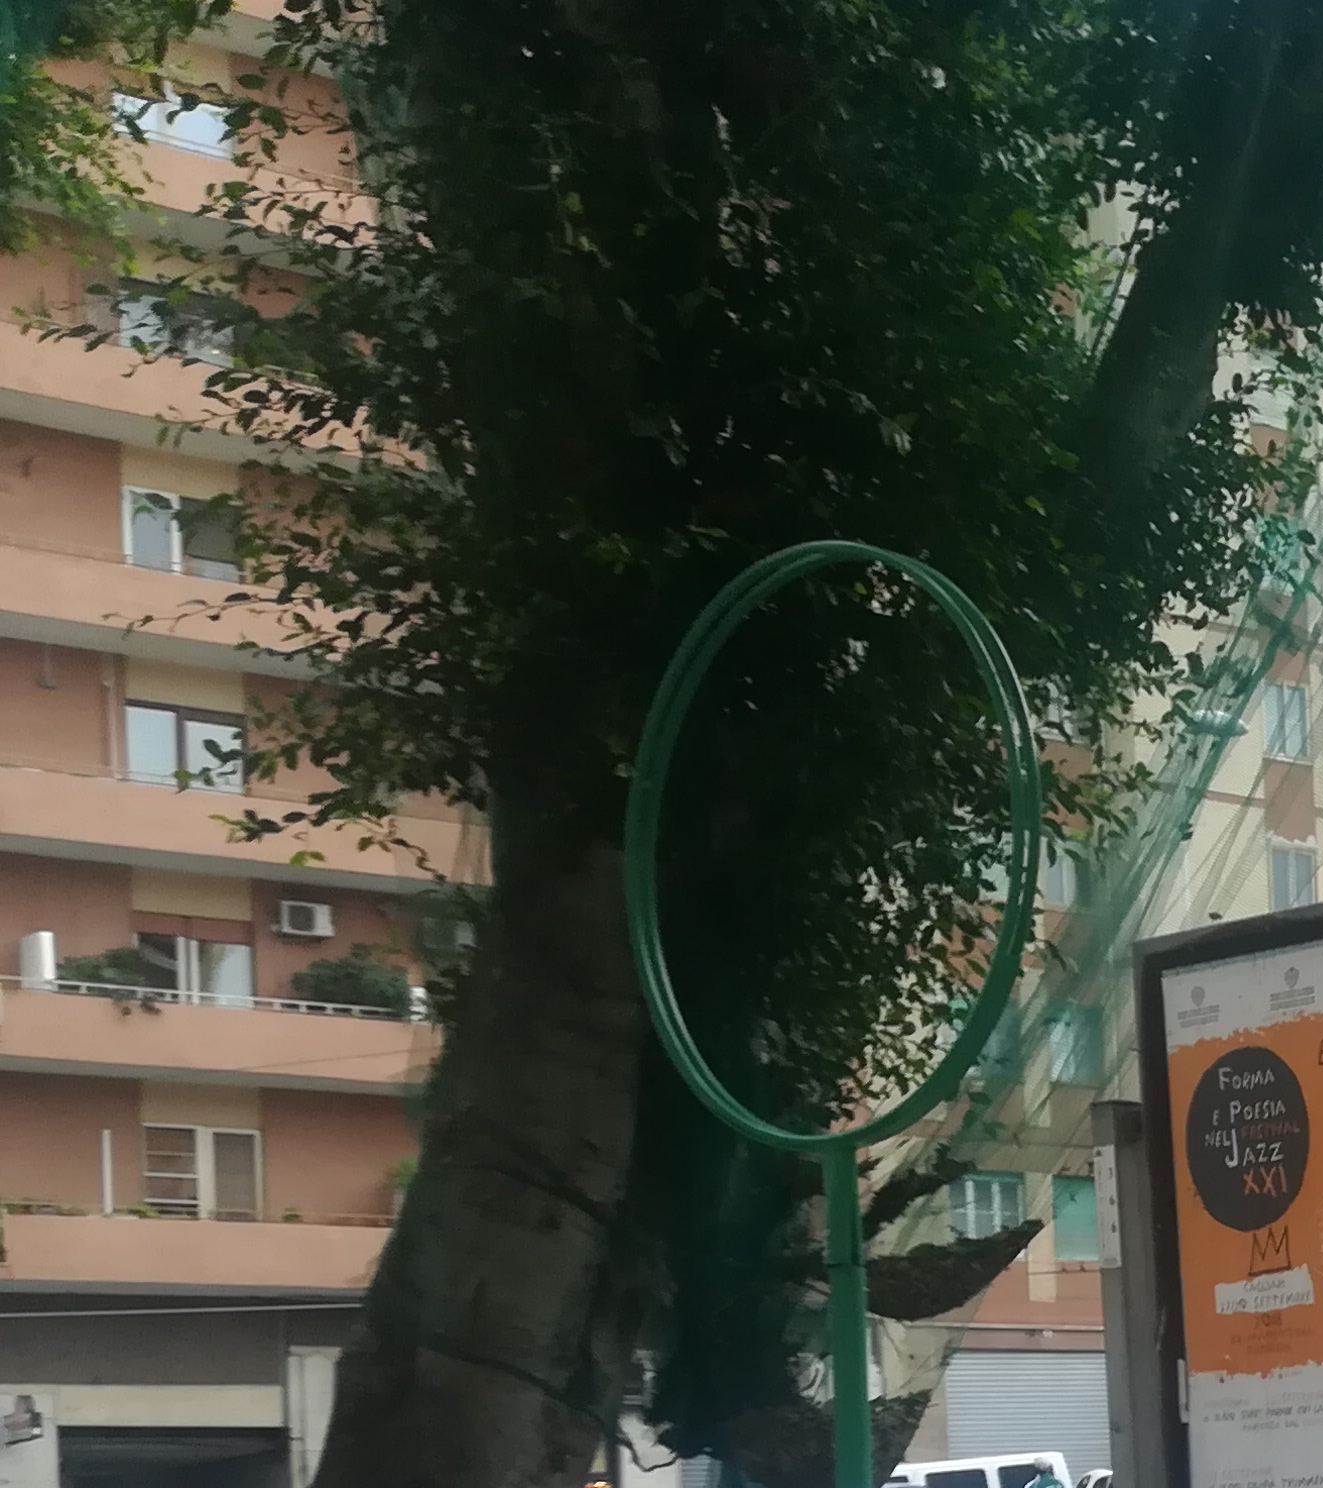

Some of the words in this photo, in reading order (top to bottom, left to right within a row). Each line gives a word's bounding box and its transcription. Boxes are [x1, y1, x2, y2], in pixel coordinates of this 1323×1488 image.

[1217, 1067, 1276, 1092] FORMA
[1229, 1100, 1287, 1124] POESIA
[1242, 1164, 1288, 1198] XXI
